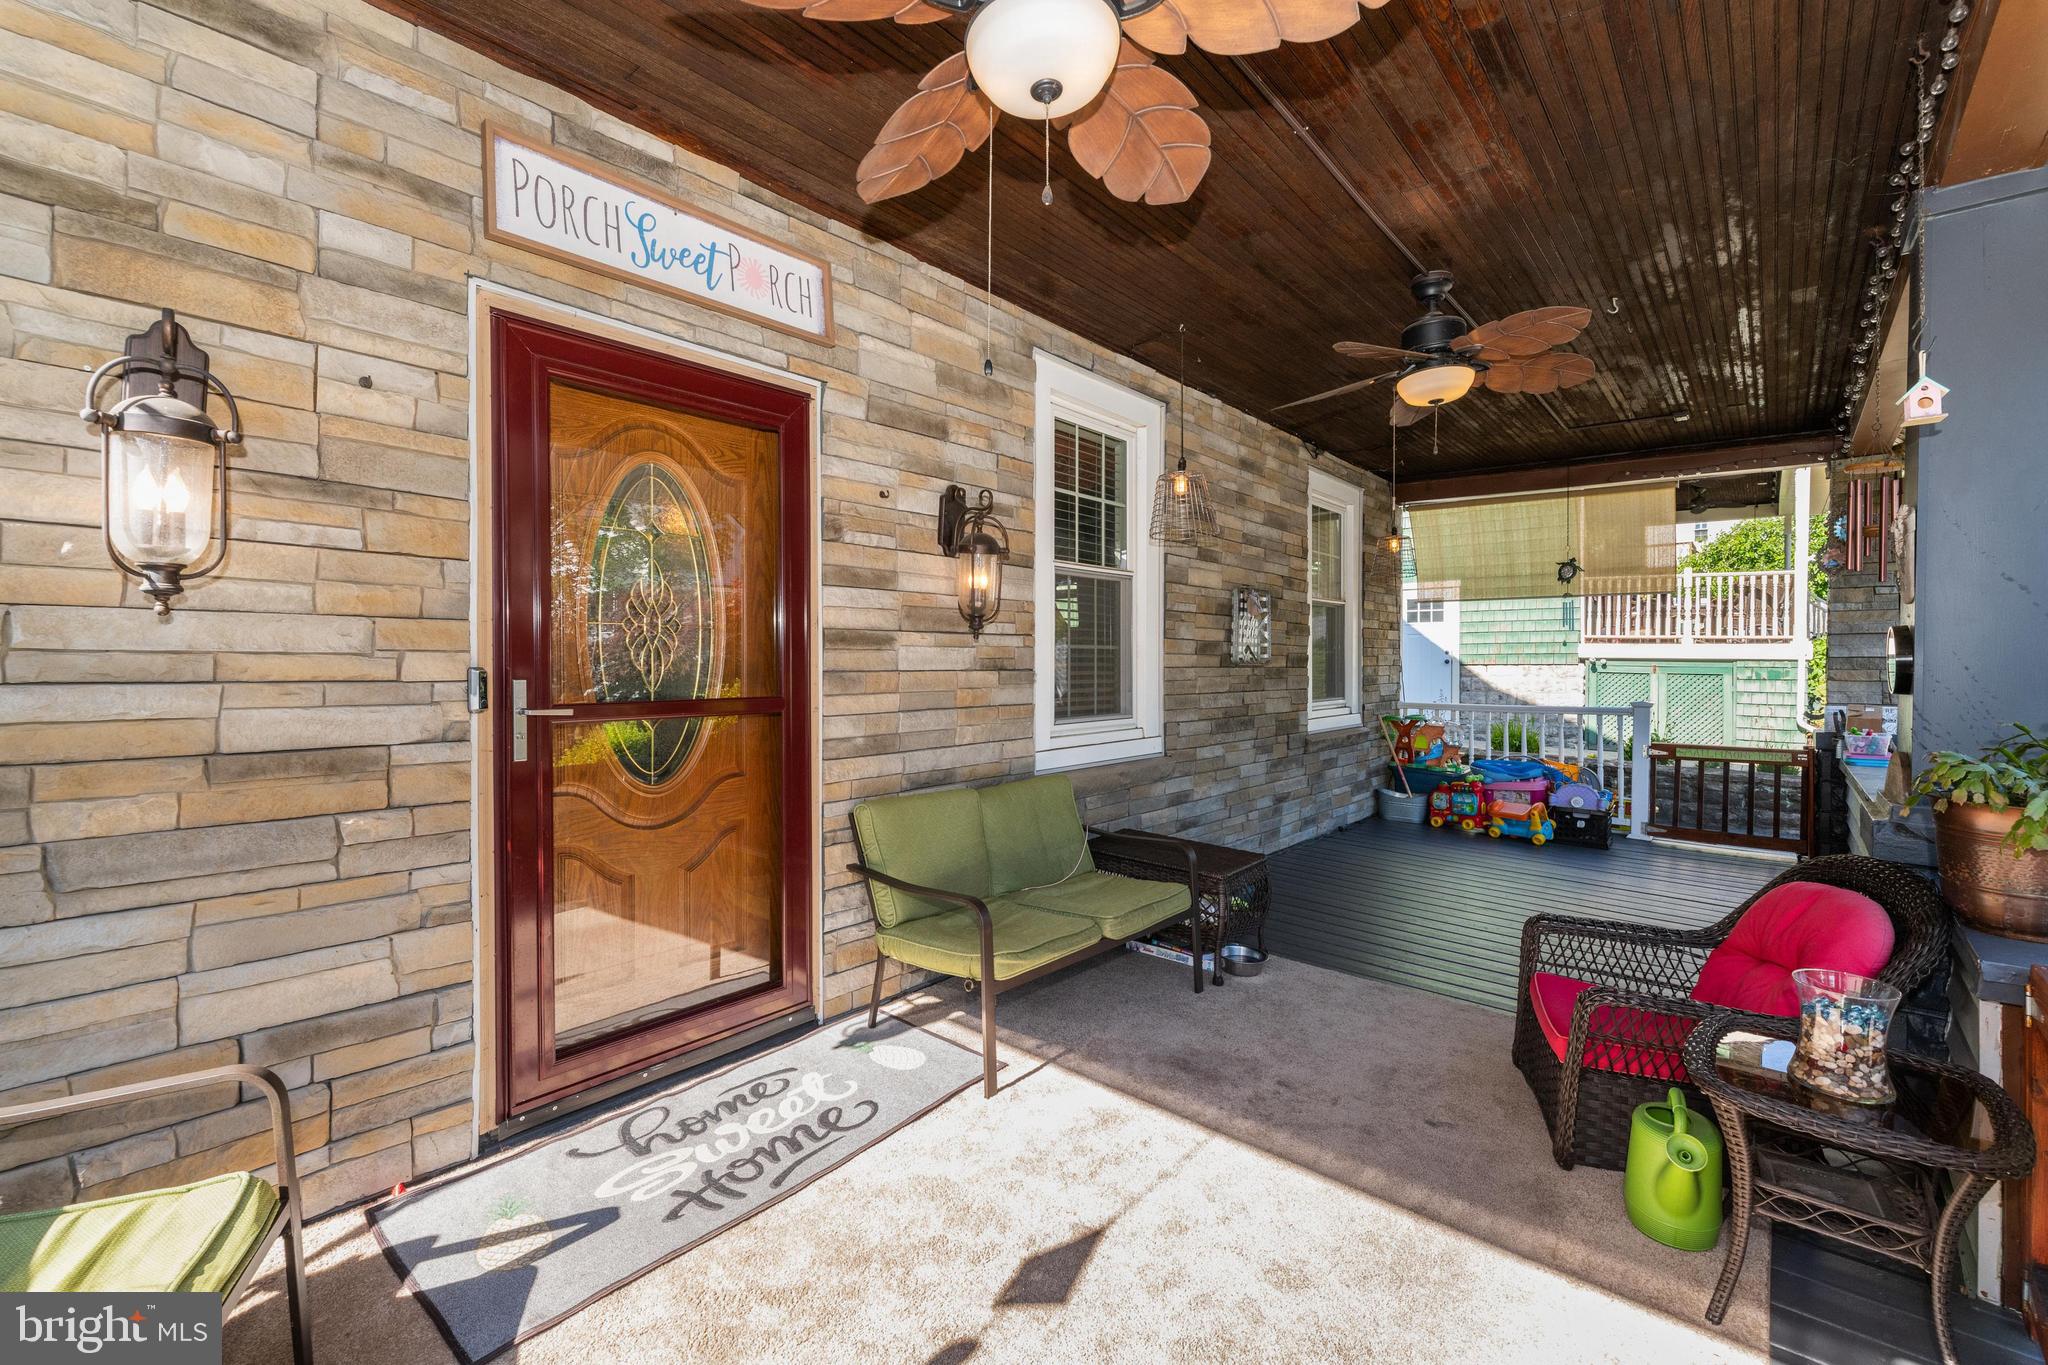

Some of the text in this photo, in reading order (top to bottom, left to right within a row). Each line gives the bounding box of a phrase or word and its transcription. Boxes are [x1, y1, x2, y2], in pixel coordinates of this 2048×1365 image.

[511, 157, 622, 253] PORCH
[624, 201, 730, 291] Sweet
[566, 1067, 798, 1158] home
[594, 1071, 858, 1201] Sweet
[661, 1100, 879, 1222] Home
